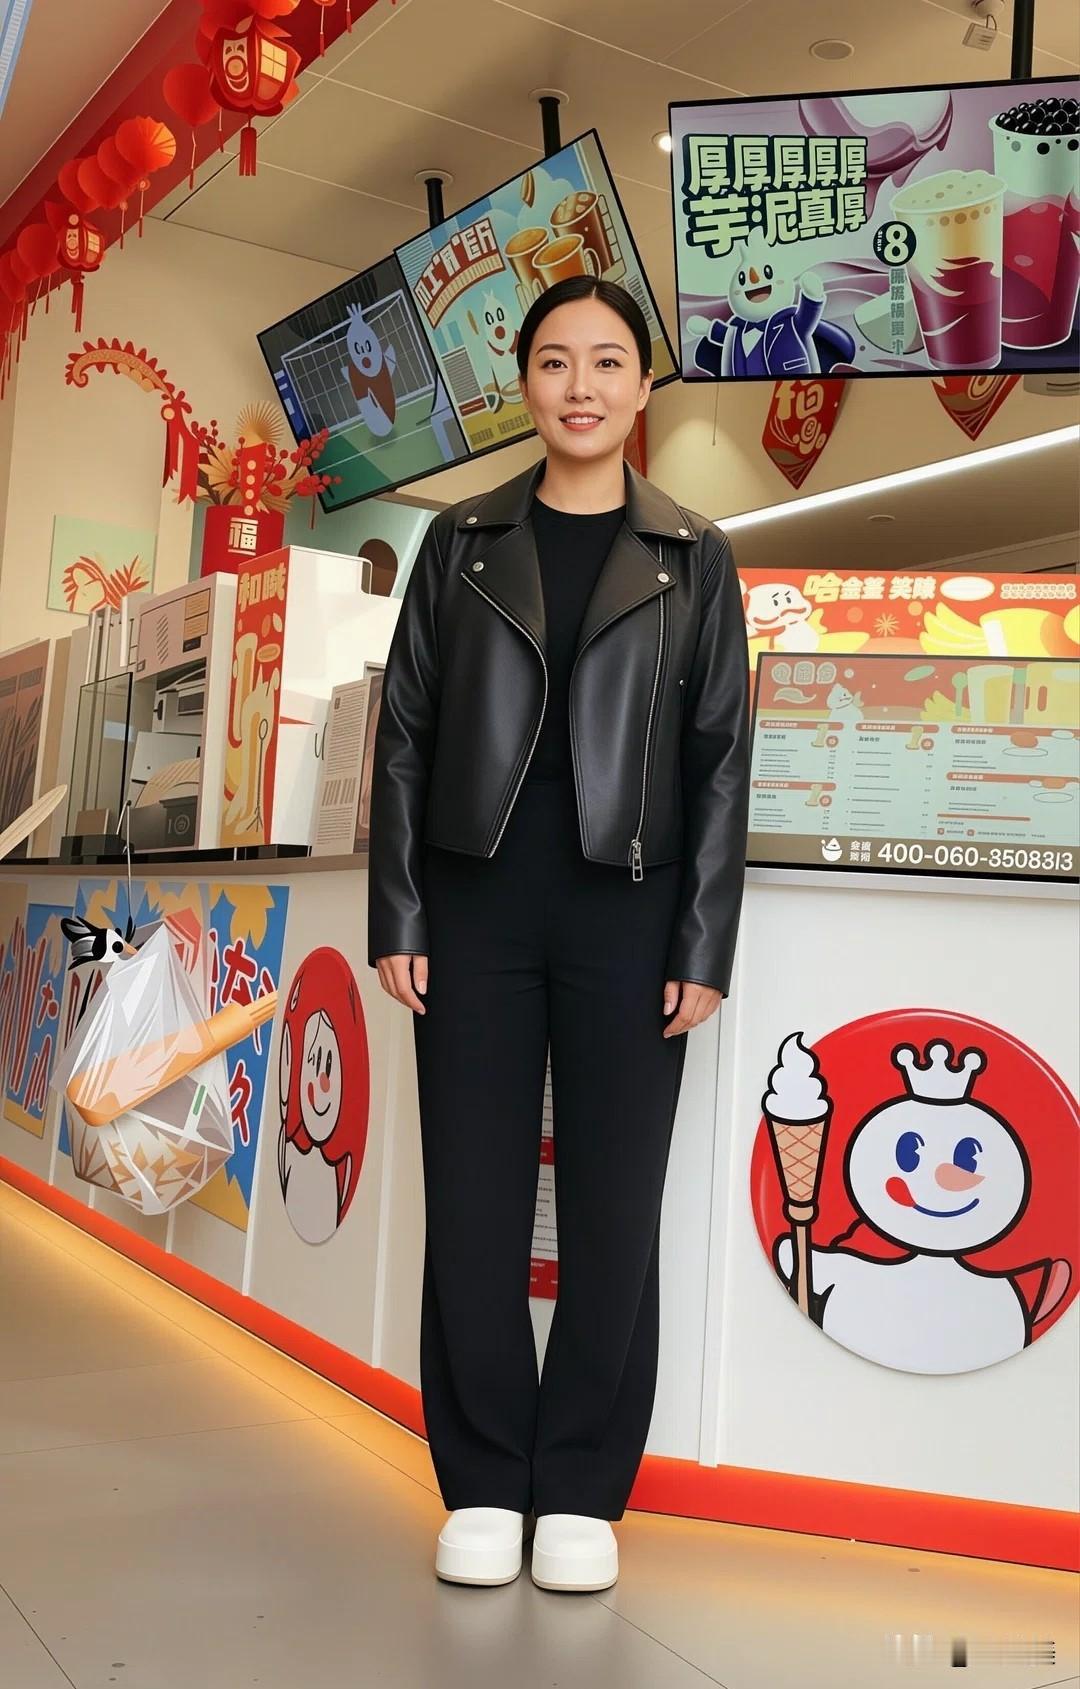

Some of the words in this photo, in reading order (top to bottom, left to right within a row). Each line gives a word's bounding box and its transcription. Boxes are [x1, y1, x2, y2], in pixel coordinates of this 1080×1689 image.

[686, 135, 868, 195] 厚厚厚厚厚
[688, 186, 868, 256] 芋泥真厚
[883, 223, 909, 263] 8
[228, 521, 258, 551] 福
